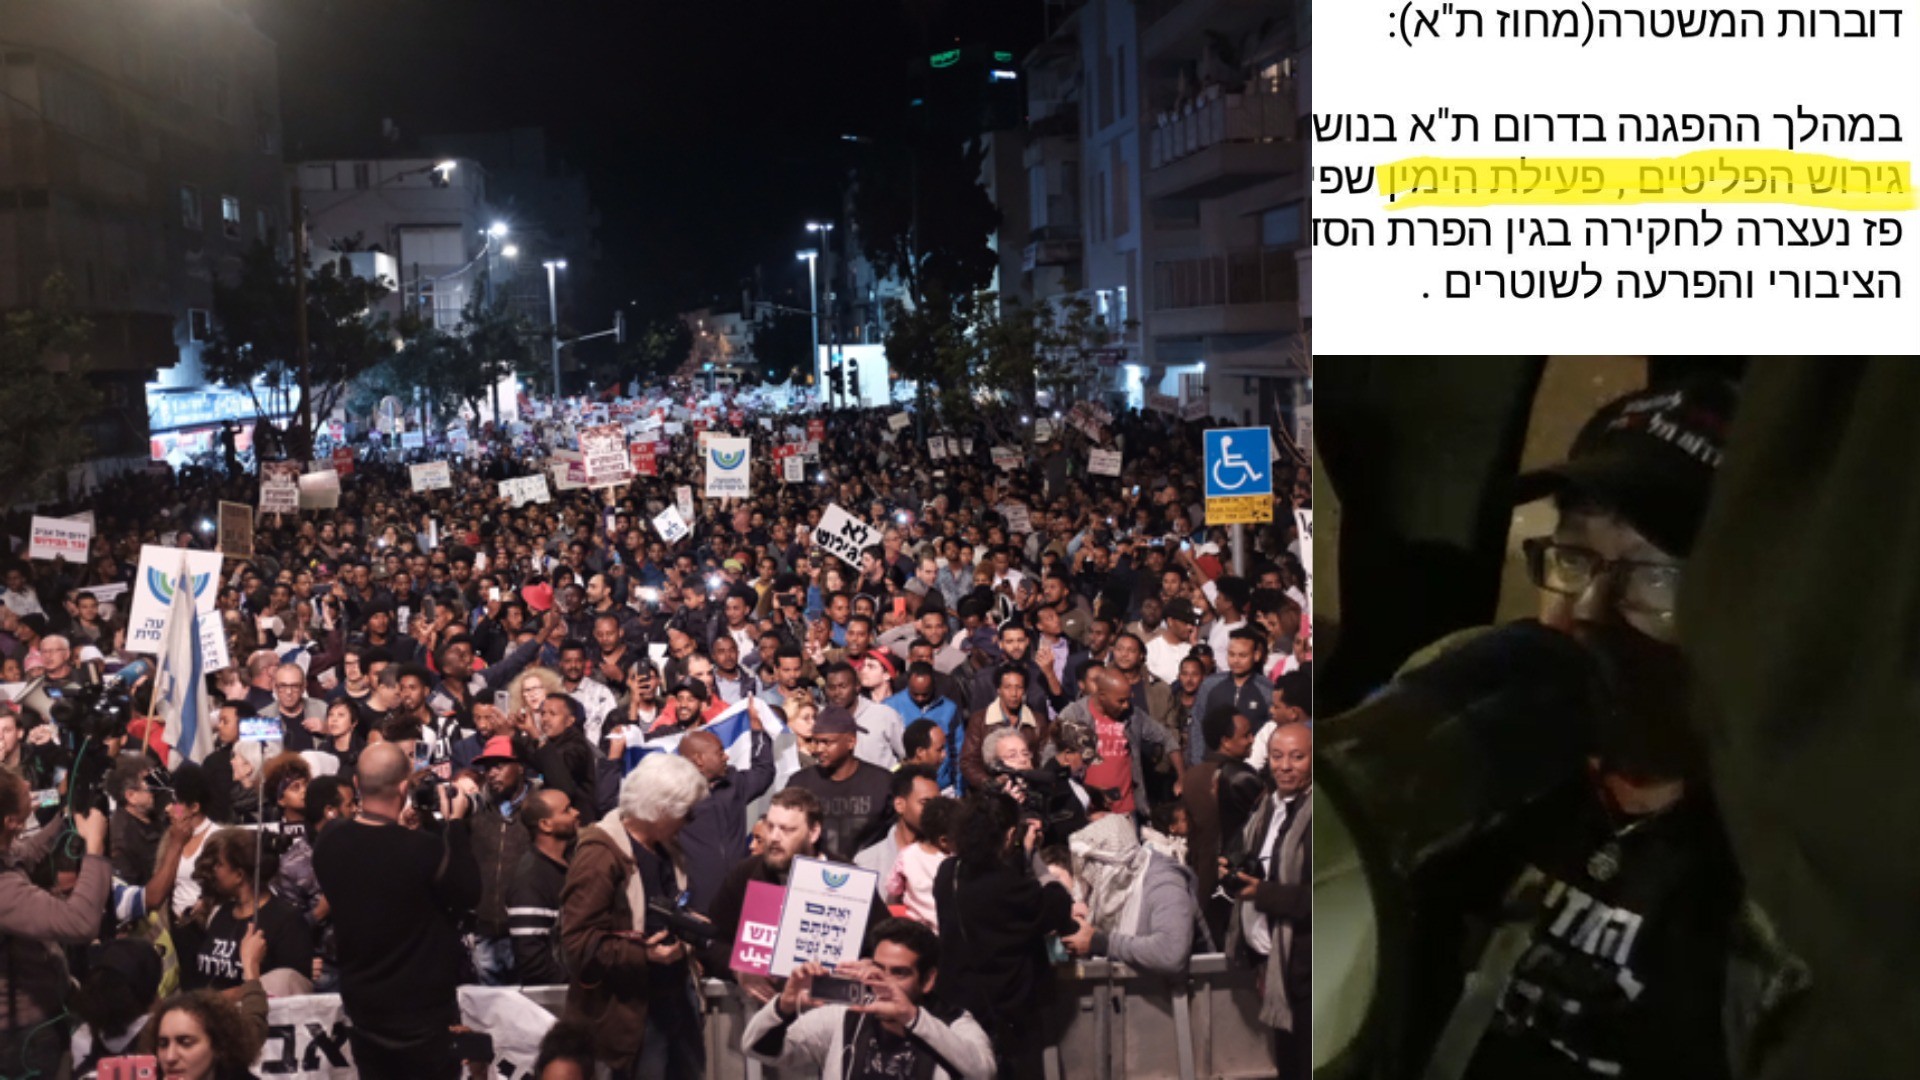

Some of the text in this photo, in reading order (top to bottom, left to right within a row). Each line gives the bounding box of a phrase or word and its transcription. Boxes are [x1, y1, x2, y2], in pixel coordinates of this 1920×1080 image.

[1778, 10, 1903, 38] דוברות
[1312, 104, 1903, 151] במהלך ההפגנה בדרום ת"א בנוש
[1389, 166, 1477, 203] הימין
[1490, 157, 1605, 194] פעילת
[1640, 157, 1793, 194] הפליטים
[1807, 165, 1903, 194] גירוש
[1387, 218, 1492, 247] הפרת
[1507, 218, 1572, 255] בגין
[1585, 208, 1723, 255] לחקירה
[1737, 218, 1850, 248] נעצרה
[1863, 218, 1903, 247] פז
[1446, 260, 1603, 300] לשוטרים
[1617, 270, 1753, 300] והפרעה
[1770, 270, 1901, 299] הציבורי
[841, 519, 868, 545] לא
